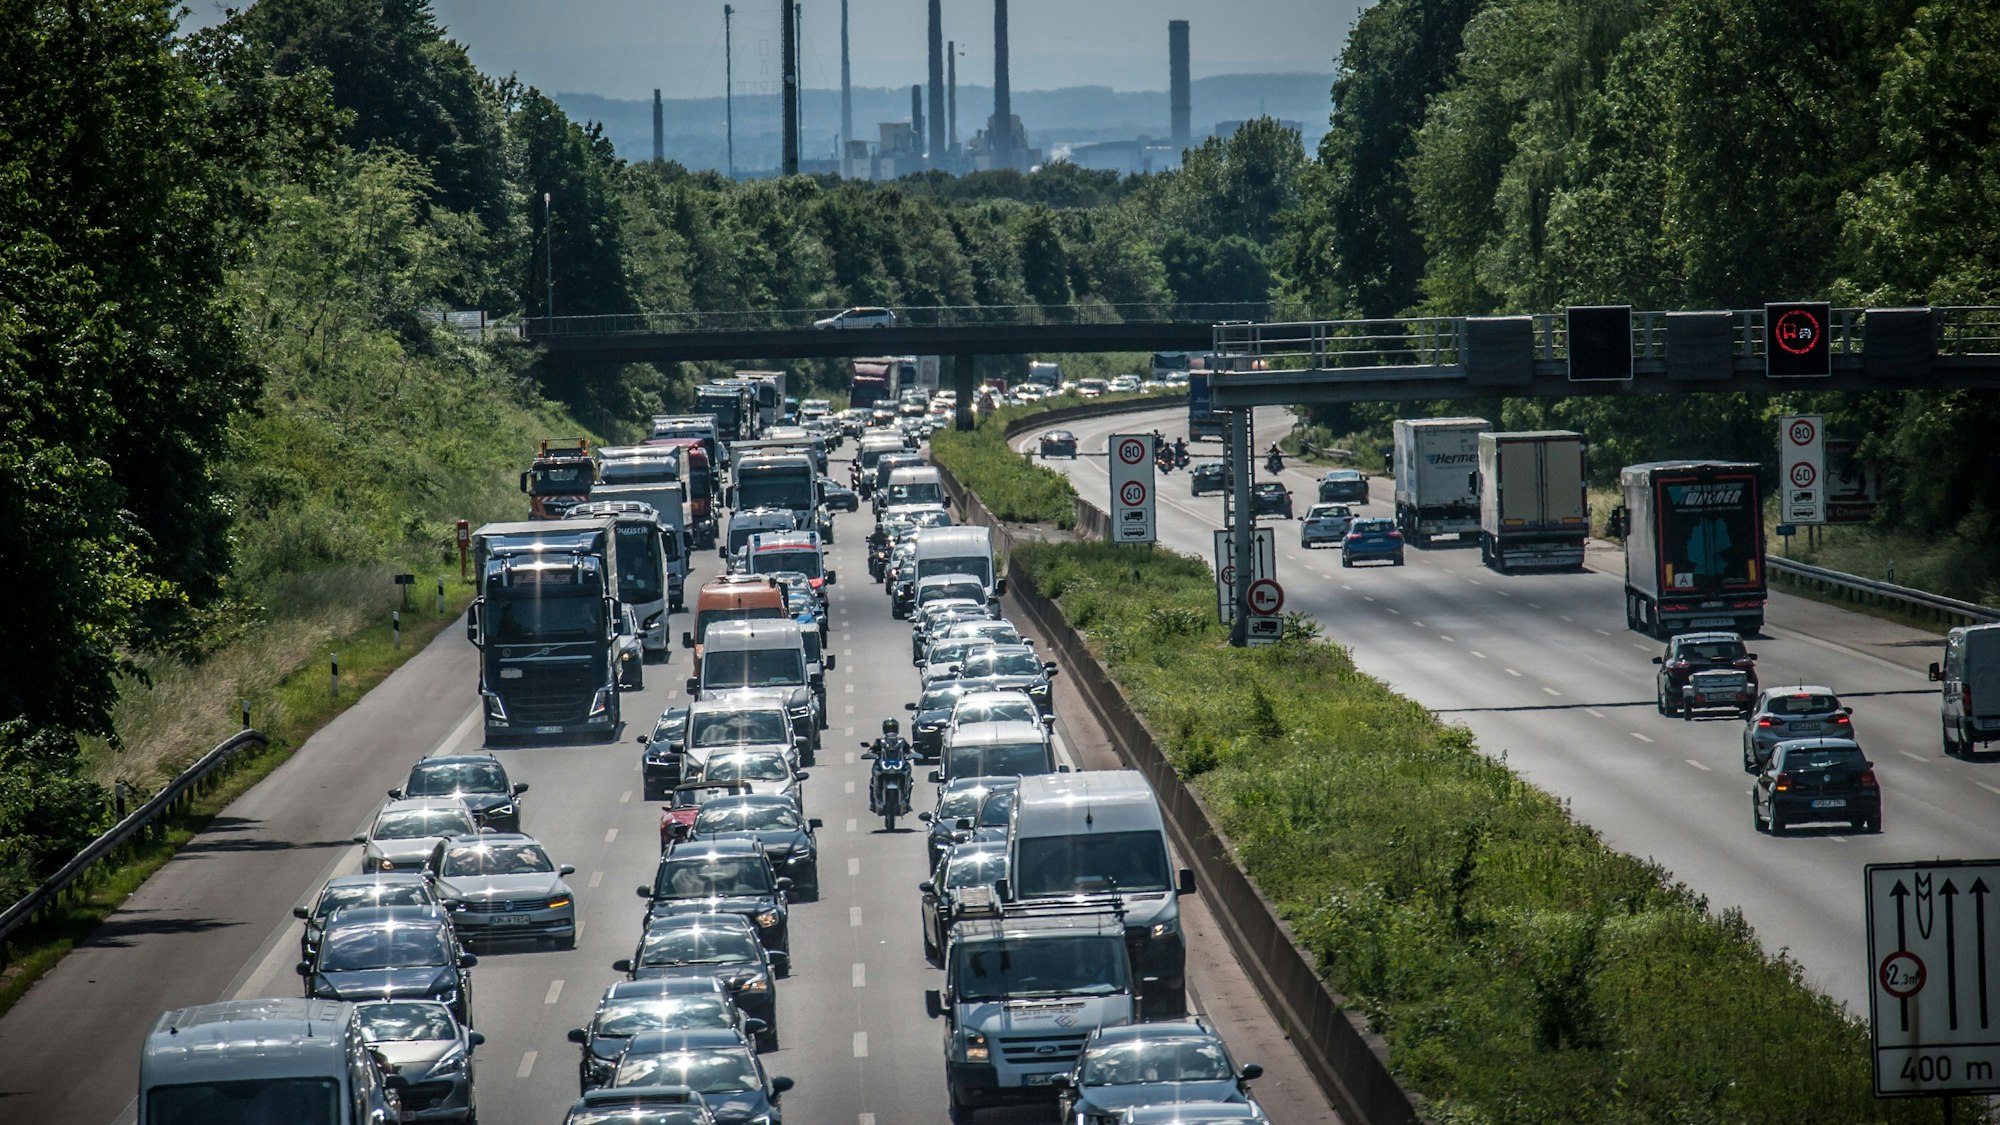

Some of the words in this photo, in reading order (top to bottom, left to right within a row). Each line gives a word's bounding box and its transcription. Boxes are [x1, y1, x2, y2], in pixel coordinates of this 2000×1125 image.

[1795, 427, 1810, 439] 80
[1124, 446, 1139, 458] 80
[1795, 469, 1810, 481] 60
[1126, 487, 1140, 500] 60
[1680, 574, 1688, 586] A
[1901, 1055, 1951, 1082] 400
[1966, 1060, 1993, 1081] m
